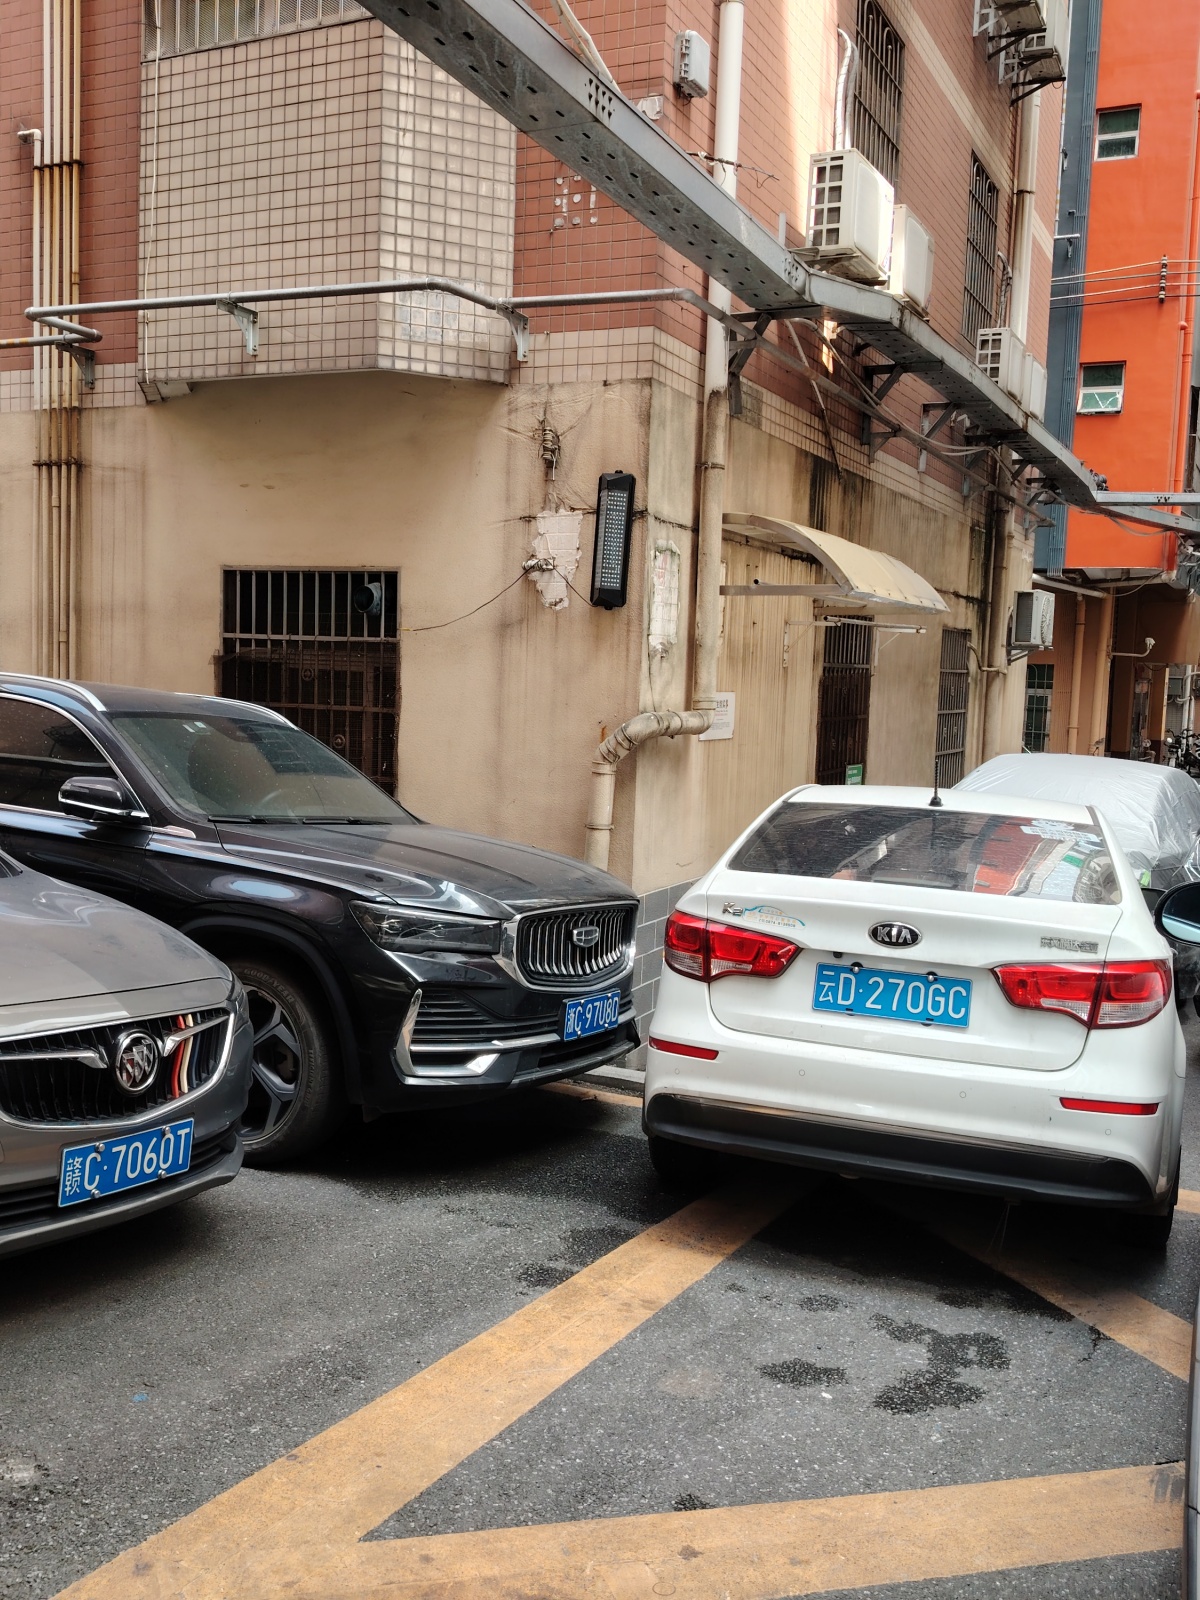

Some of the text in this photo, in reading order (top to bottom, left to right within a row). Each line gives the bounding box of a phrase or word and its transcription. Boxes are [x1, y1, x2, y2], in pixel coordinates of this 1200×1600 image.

[722, 902, 743, 917] K2
[877, 925, 912, 944] KIA
[819, 970, 967, 1019] 云D·270GC
[64, 1127, 191, 1197] 赣C·7060T
